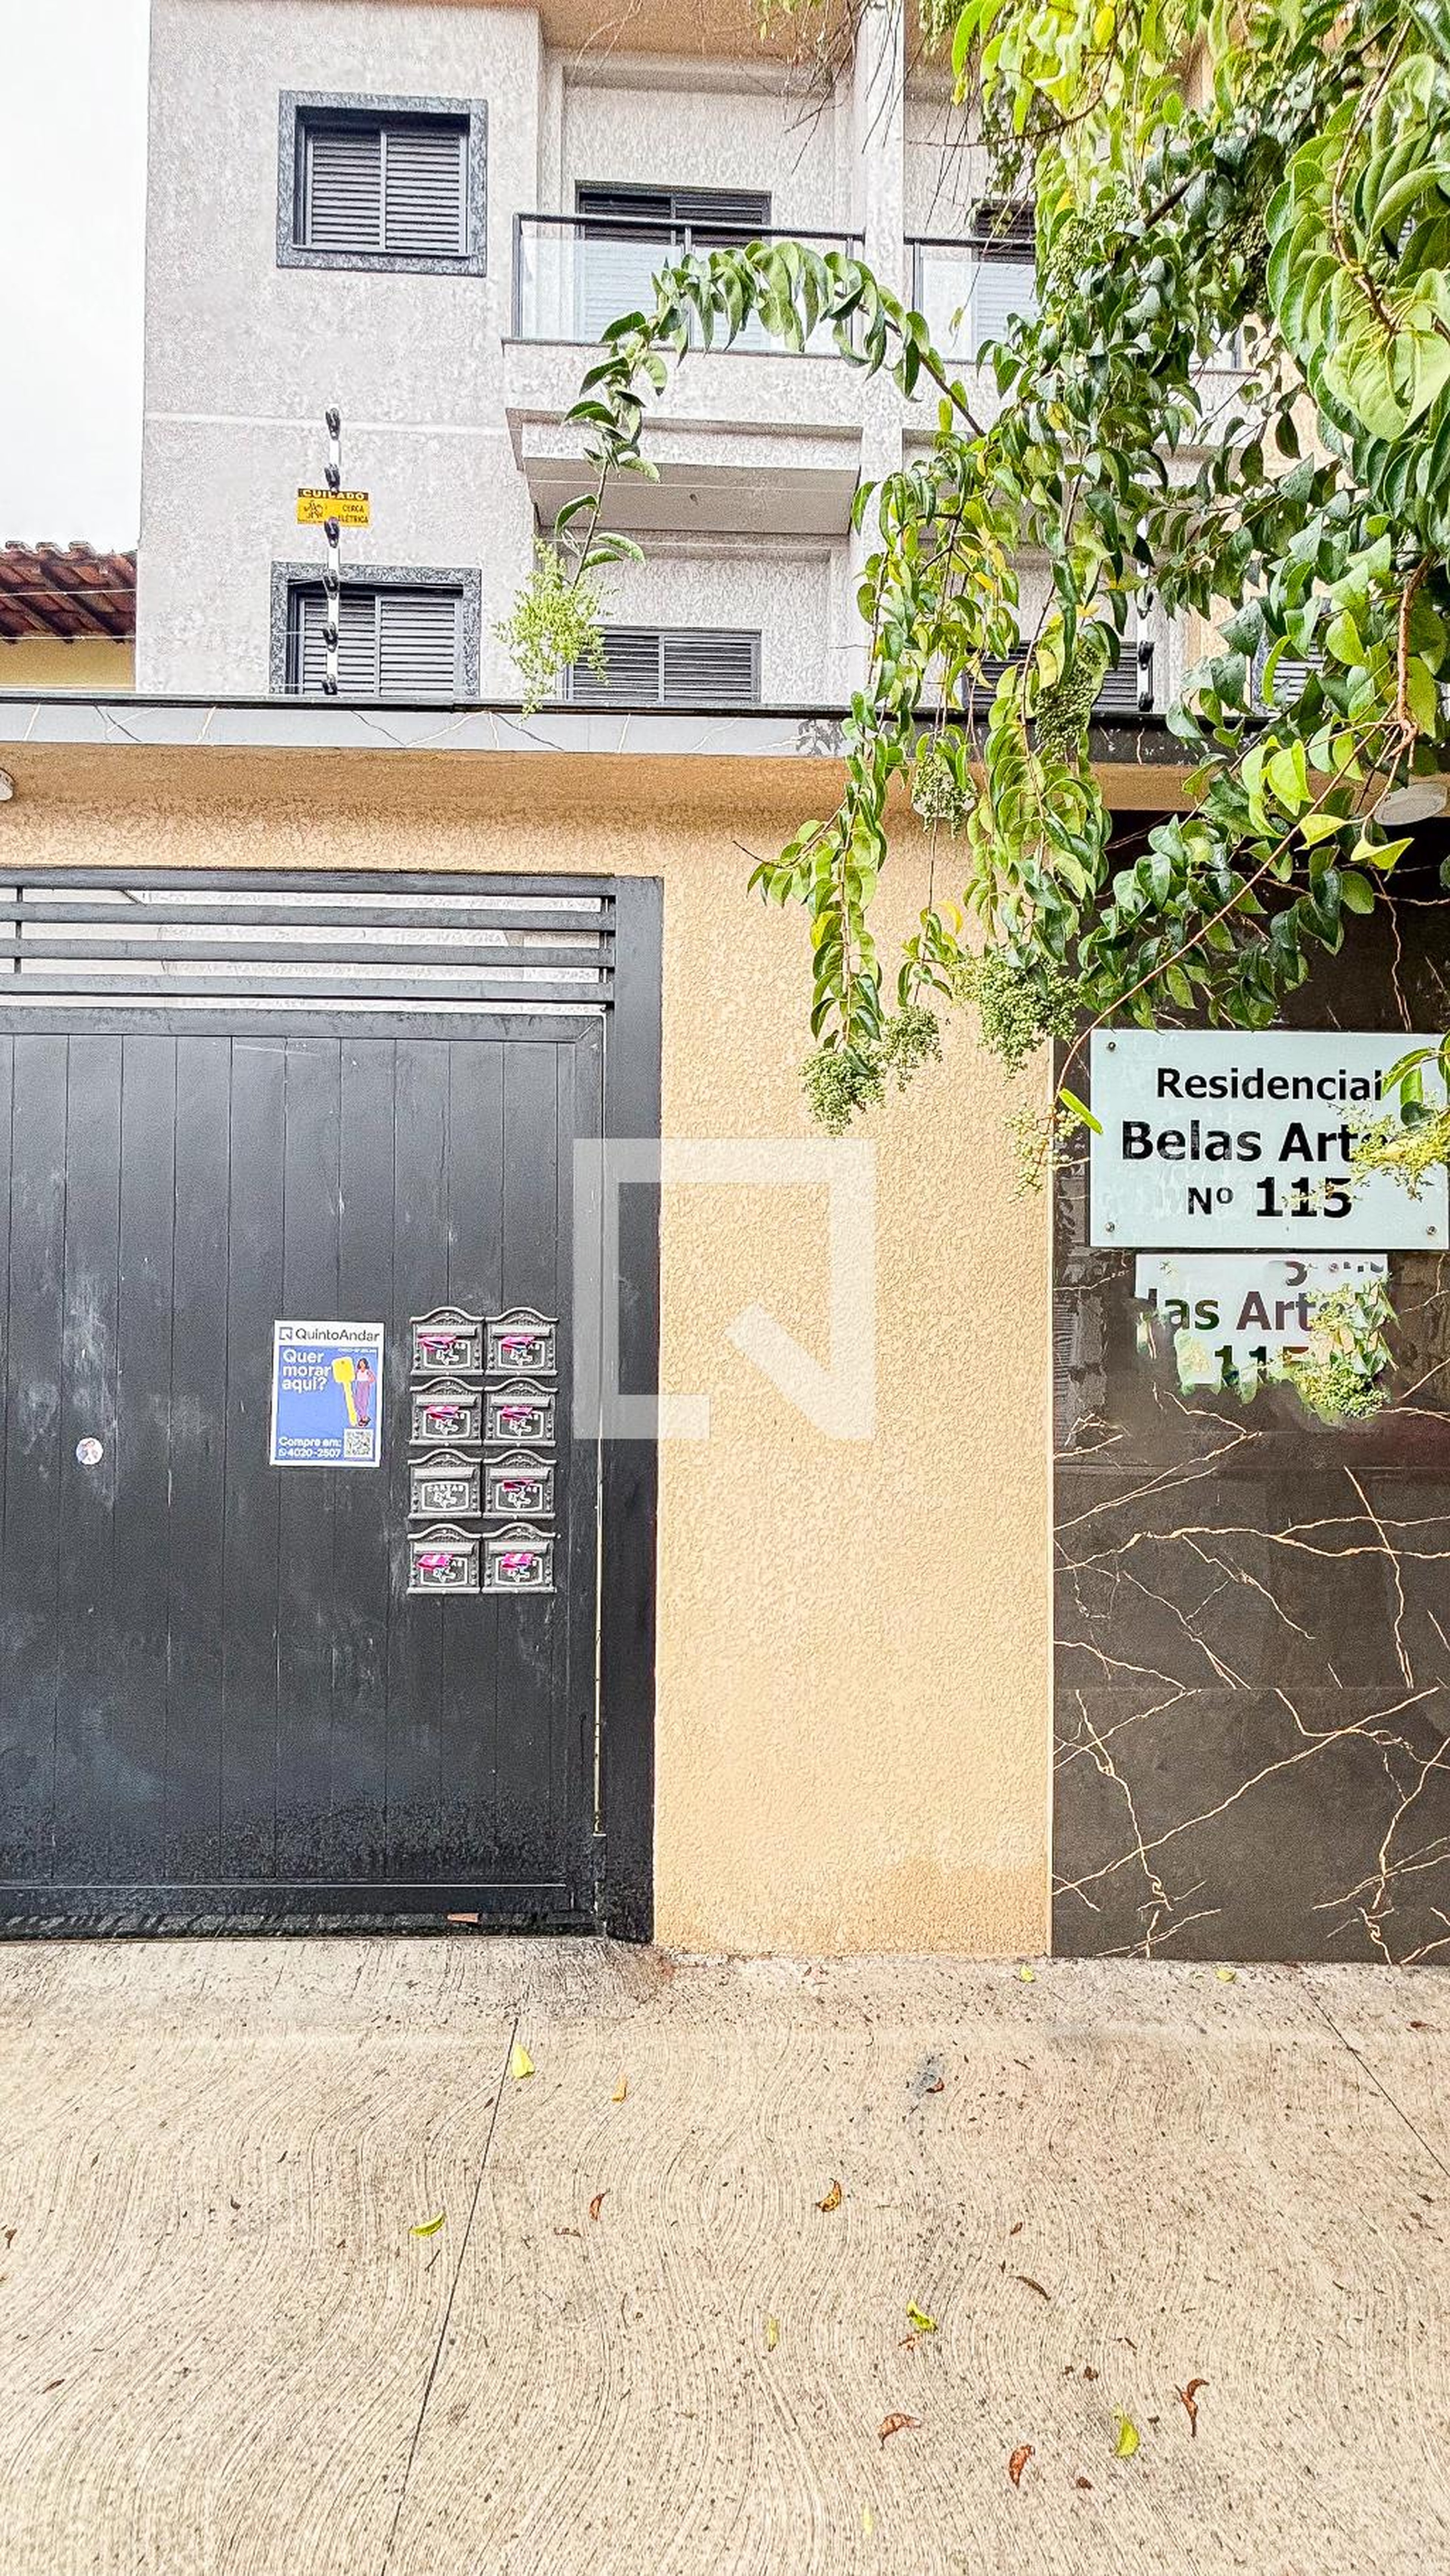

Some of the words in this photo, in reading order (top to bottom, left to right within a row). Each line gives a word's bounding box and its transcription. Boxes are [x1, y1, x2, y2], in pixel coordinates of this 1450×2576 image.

[1122, 1120, 1262, 1162] Belas
[1257, 1176, 1353, 1218] 115
[296, 1328, 380, 1341] QuintoAndar
[283, 1349, 324, 1364] Quer
[283, 1366, 332, 1377] morar
[282, 1377, 327, 1394] aqui?
[288, 1448, 341, 1458] 4020-2507
